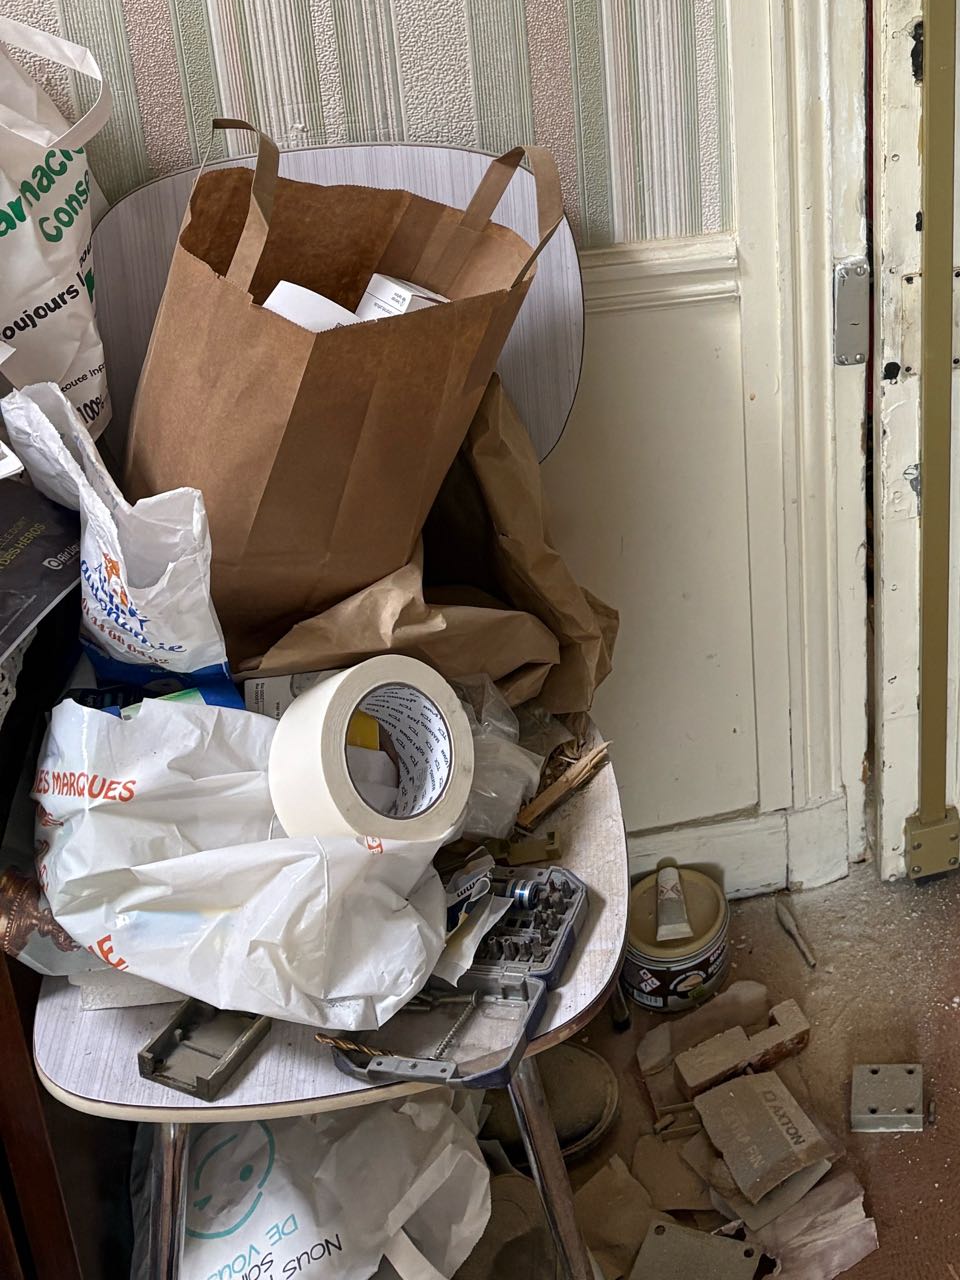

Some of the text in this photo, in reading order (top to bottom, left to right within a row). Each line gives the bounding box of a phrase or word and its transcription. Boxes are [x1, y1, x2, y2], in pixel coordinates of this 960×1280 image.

[0, 282, 80, 344] oujours
[52, 770, 137, 803] MARQUES
[266, 1214, 299, 1246] DE
[282, 1233, 343, 1280] NOUS
